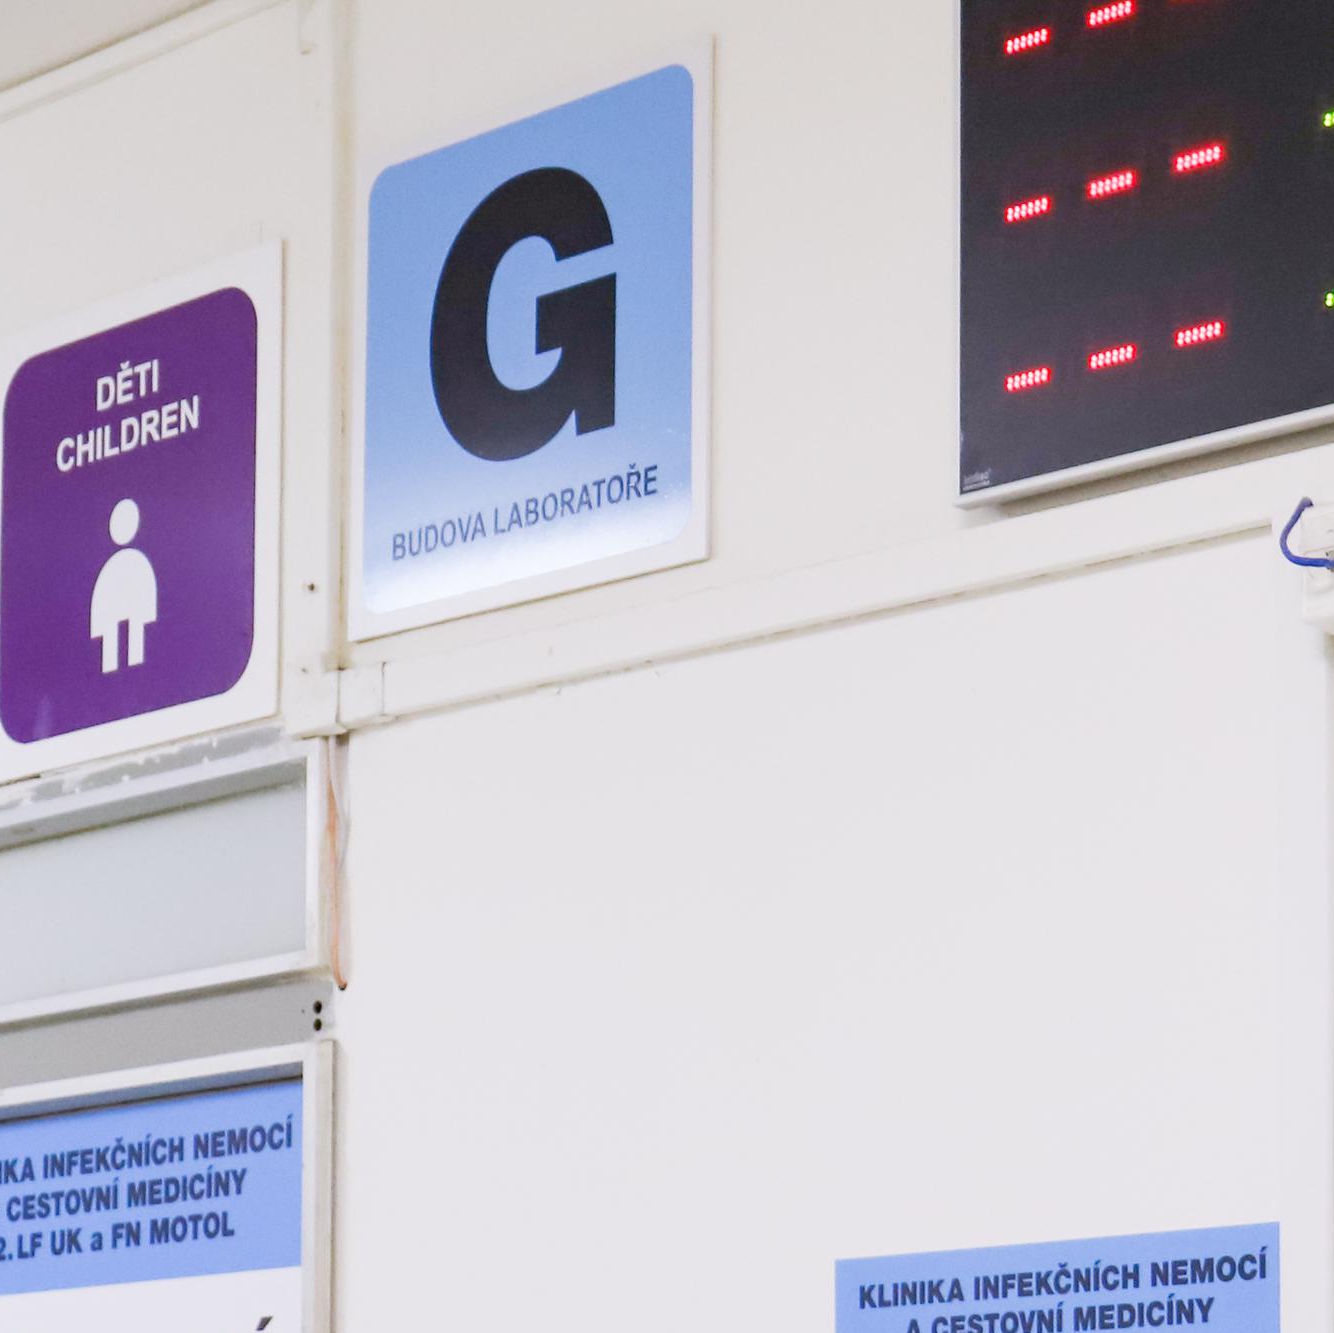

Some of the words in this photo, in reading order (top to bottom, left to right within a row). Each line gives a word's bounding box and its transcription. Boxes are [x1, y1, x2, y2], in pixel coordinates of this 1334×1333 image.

[429, 166, 617, 462] G
[96, 359, 160, 411] DĚTI
[56, 395, 200, 472] CHILDREN
[391, 513, 486, 561] BUDOVA
[493, 462, 659, 535] LABORATOŘE
[42, 1134, 185, 1179] INFEKČNÍCH
[193, 1114, 294, 1160] NEMOCÍ
[7, 1178, 121, 1222] CESTOVNÍ
[127, 1166, 247, 1209] MEDICÍNY
[50, 1226, 82, 1256] UK
[90, 1228, 104, 1251] a
[112, 1218, 142, 1248] FN
[149, 1211, 235, 1243] MOTOL
[859, 1278, 965, 1309] KLINIKA
[974, 1261, 1141, 1300] INFEKČNÍCH
[1151, 1246, 1268, 1287] NEMOCÍ
[1073, 1293, 1215, 1333] MEDICÍNY
